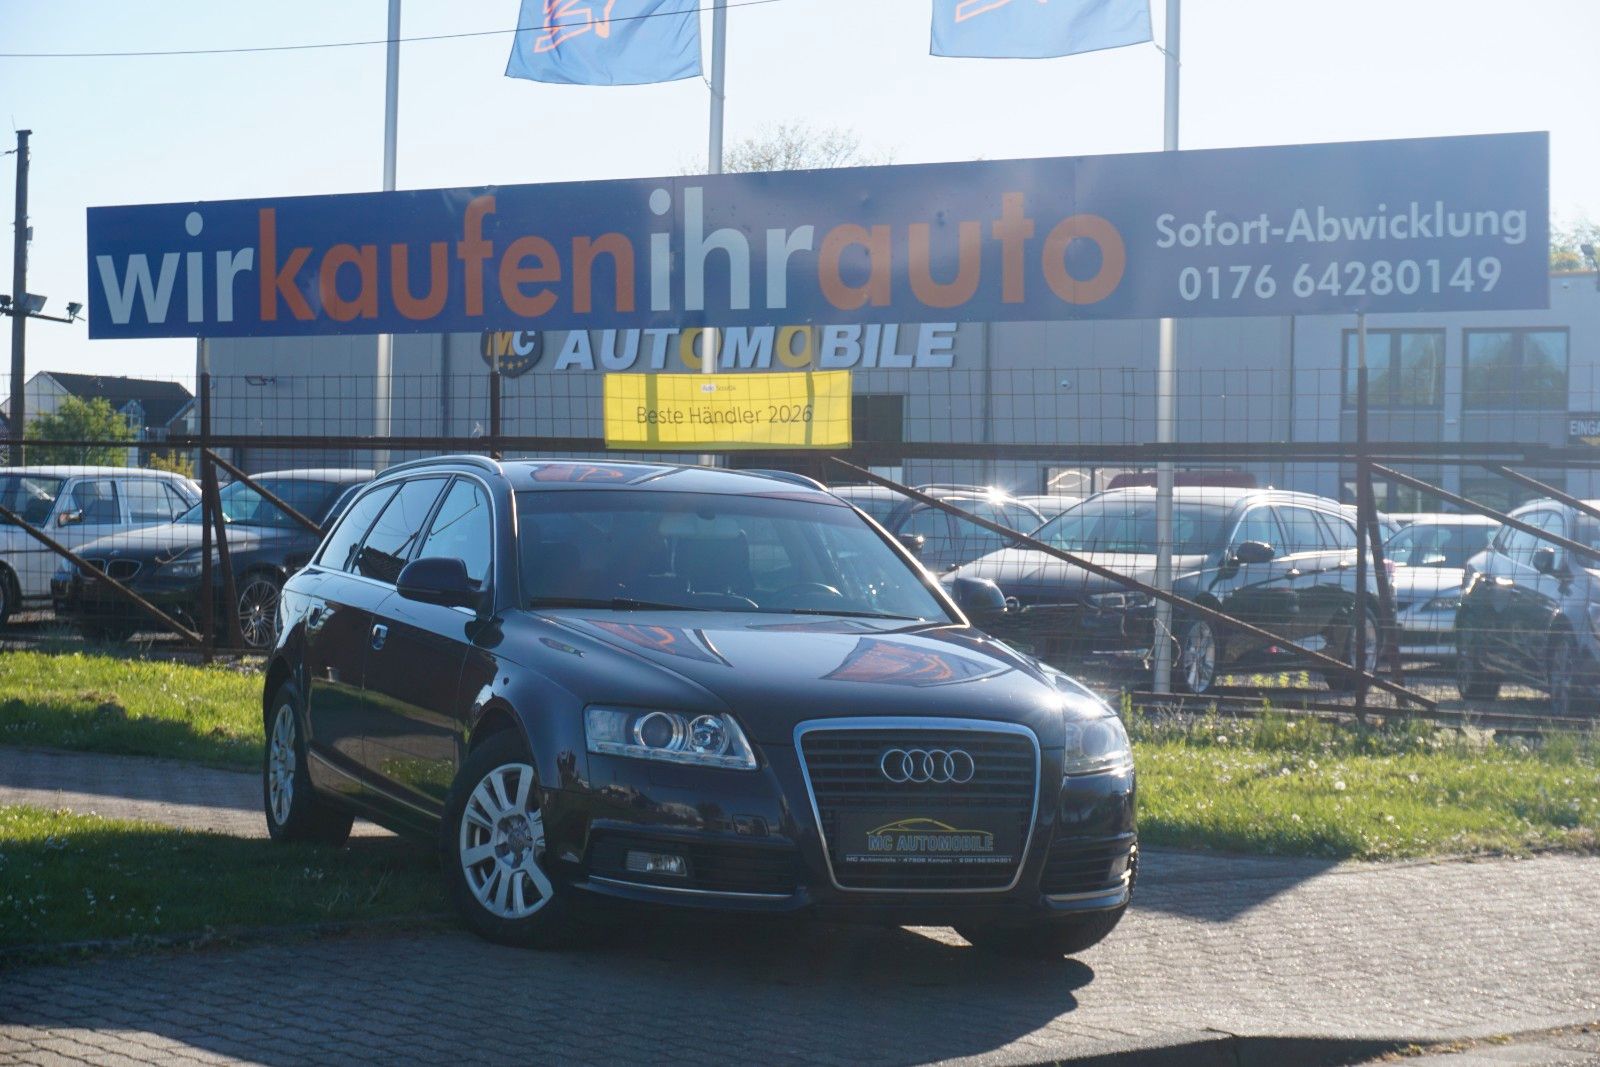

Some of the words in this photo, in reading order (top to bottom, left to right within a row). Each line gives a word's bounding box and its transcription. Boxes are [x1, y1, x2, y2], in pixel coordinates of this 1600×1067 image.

[1155, 201, 1527, 249] Sofort-Abwicklung
[1178, 265, 1276, 301] 0176
[1292, 256, 1501, 298] 64280149
[486, 330, 535, 357] MC
[553, 322, 957, 370] AUTOMOBILE
[636, 406, 684, 424] Beste
[689, 406, 762, 425] Händler
[768, 404, 813, 424] 2026
[868, 835, 893, 851] MC
[896, 835, 993, 851] AUTOMOBILE
